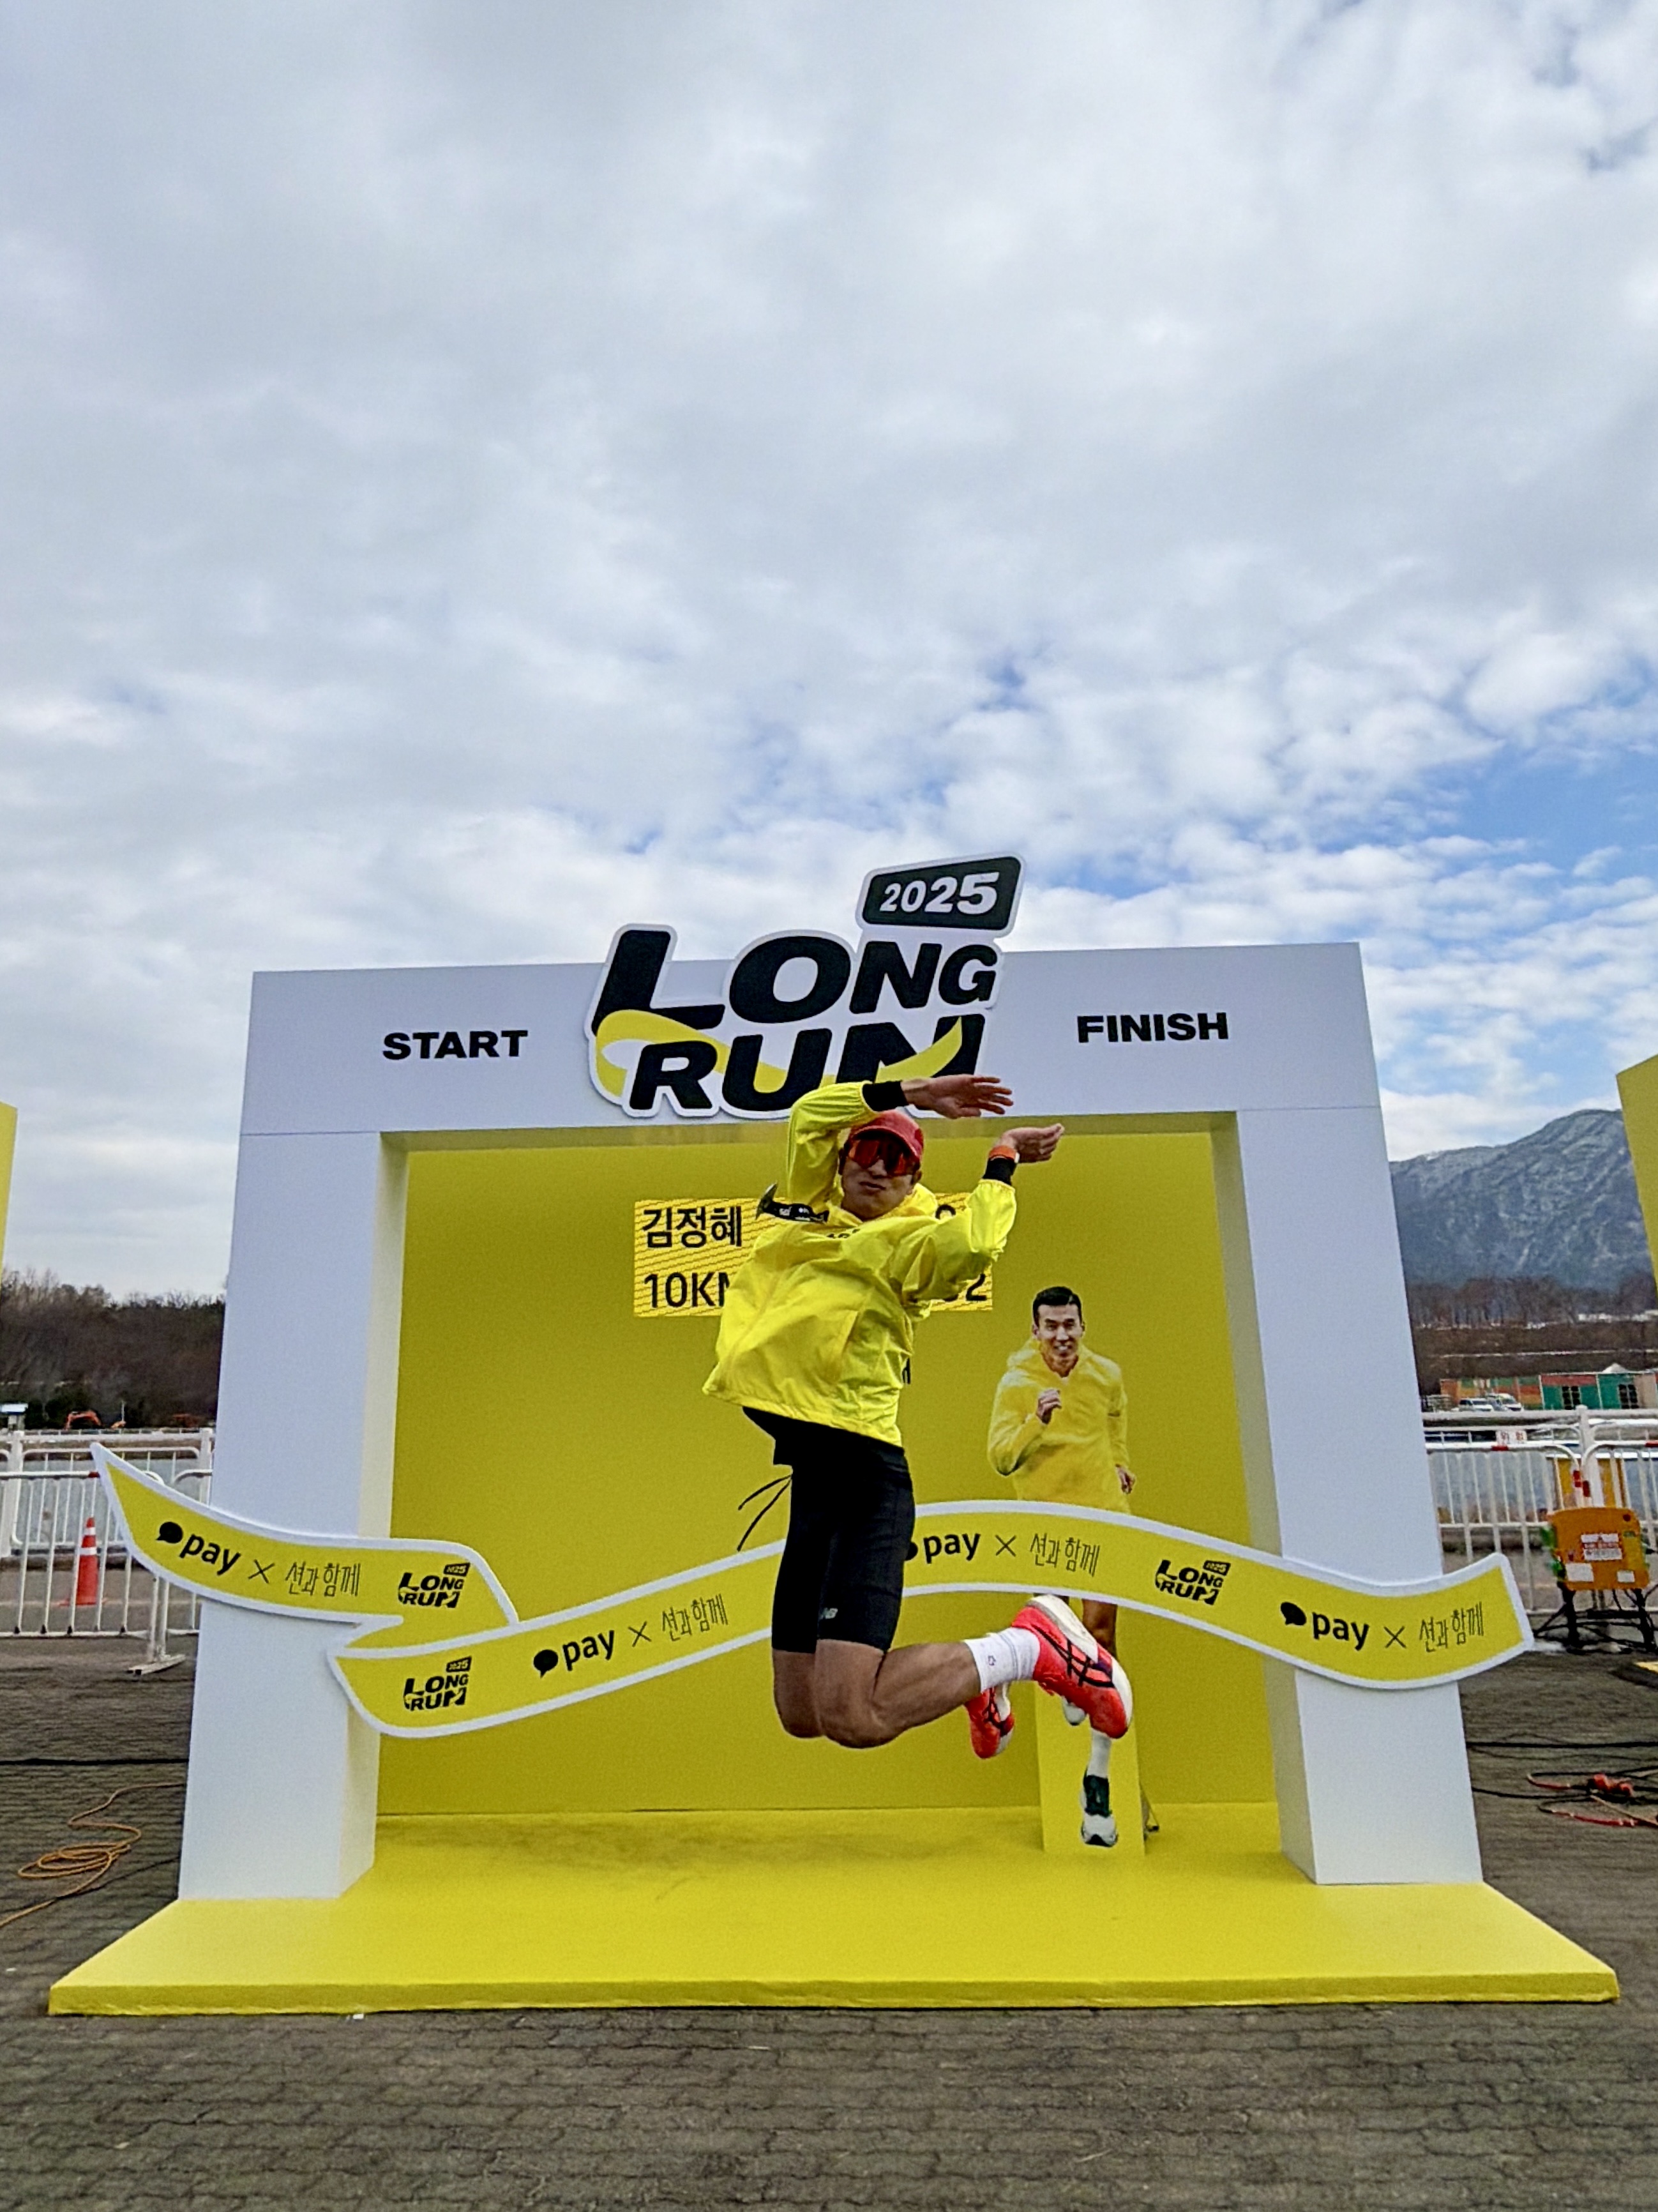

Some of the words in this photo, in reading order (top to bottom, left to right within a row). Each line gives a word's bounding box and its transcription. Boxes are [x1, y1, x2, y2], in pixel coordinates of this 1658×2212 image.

[879, 871, 1000, 914] 2025
[592, 929, 998, 1033] LONG
[1076, 1011, 1229, 1043] FINISH
[382, 1029, 529, 1061] START
[629, 1013, 986, 1111] RUN
[642, 1206, 742, 1248] 김정혜
[179, 1533, 241, 1576] pay
[923, 1533, 981, 1564] pay
[399, 1572, 465, 1591] LONG
[1156, 1559, 1224, 1588] LONG
[403, 1591, 461, 1609] RUN
[1160, 1580, 1219, 1605] RUN
[1312, 1612, 1370, 1651] pay
[562, 1630, 615, 1672] pay
[404, 1674, 469, 1696] LONG
[410, 1687, 467, 1711] RUN
